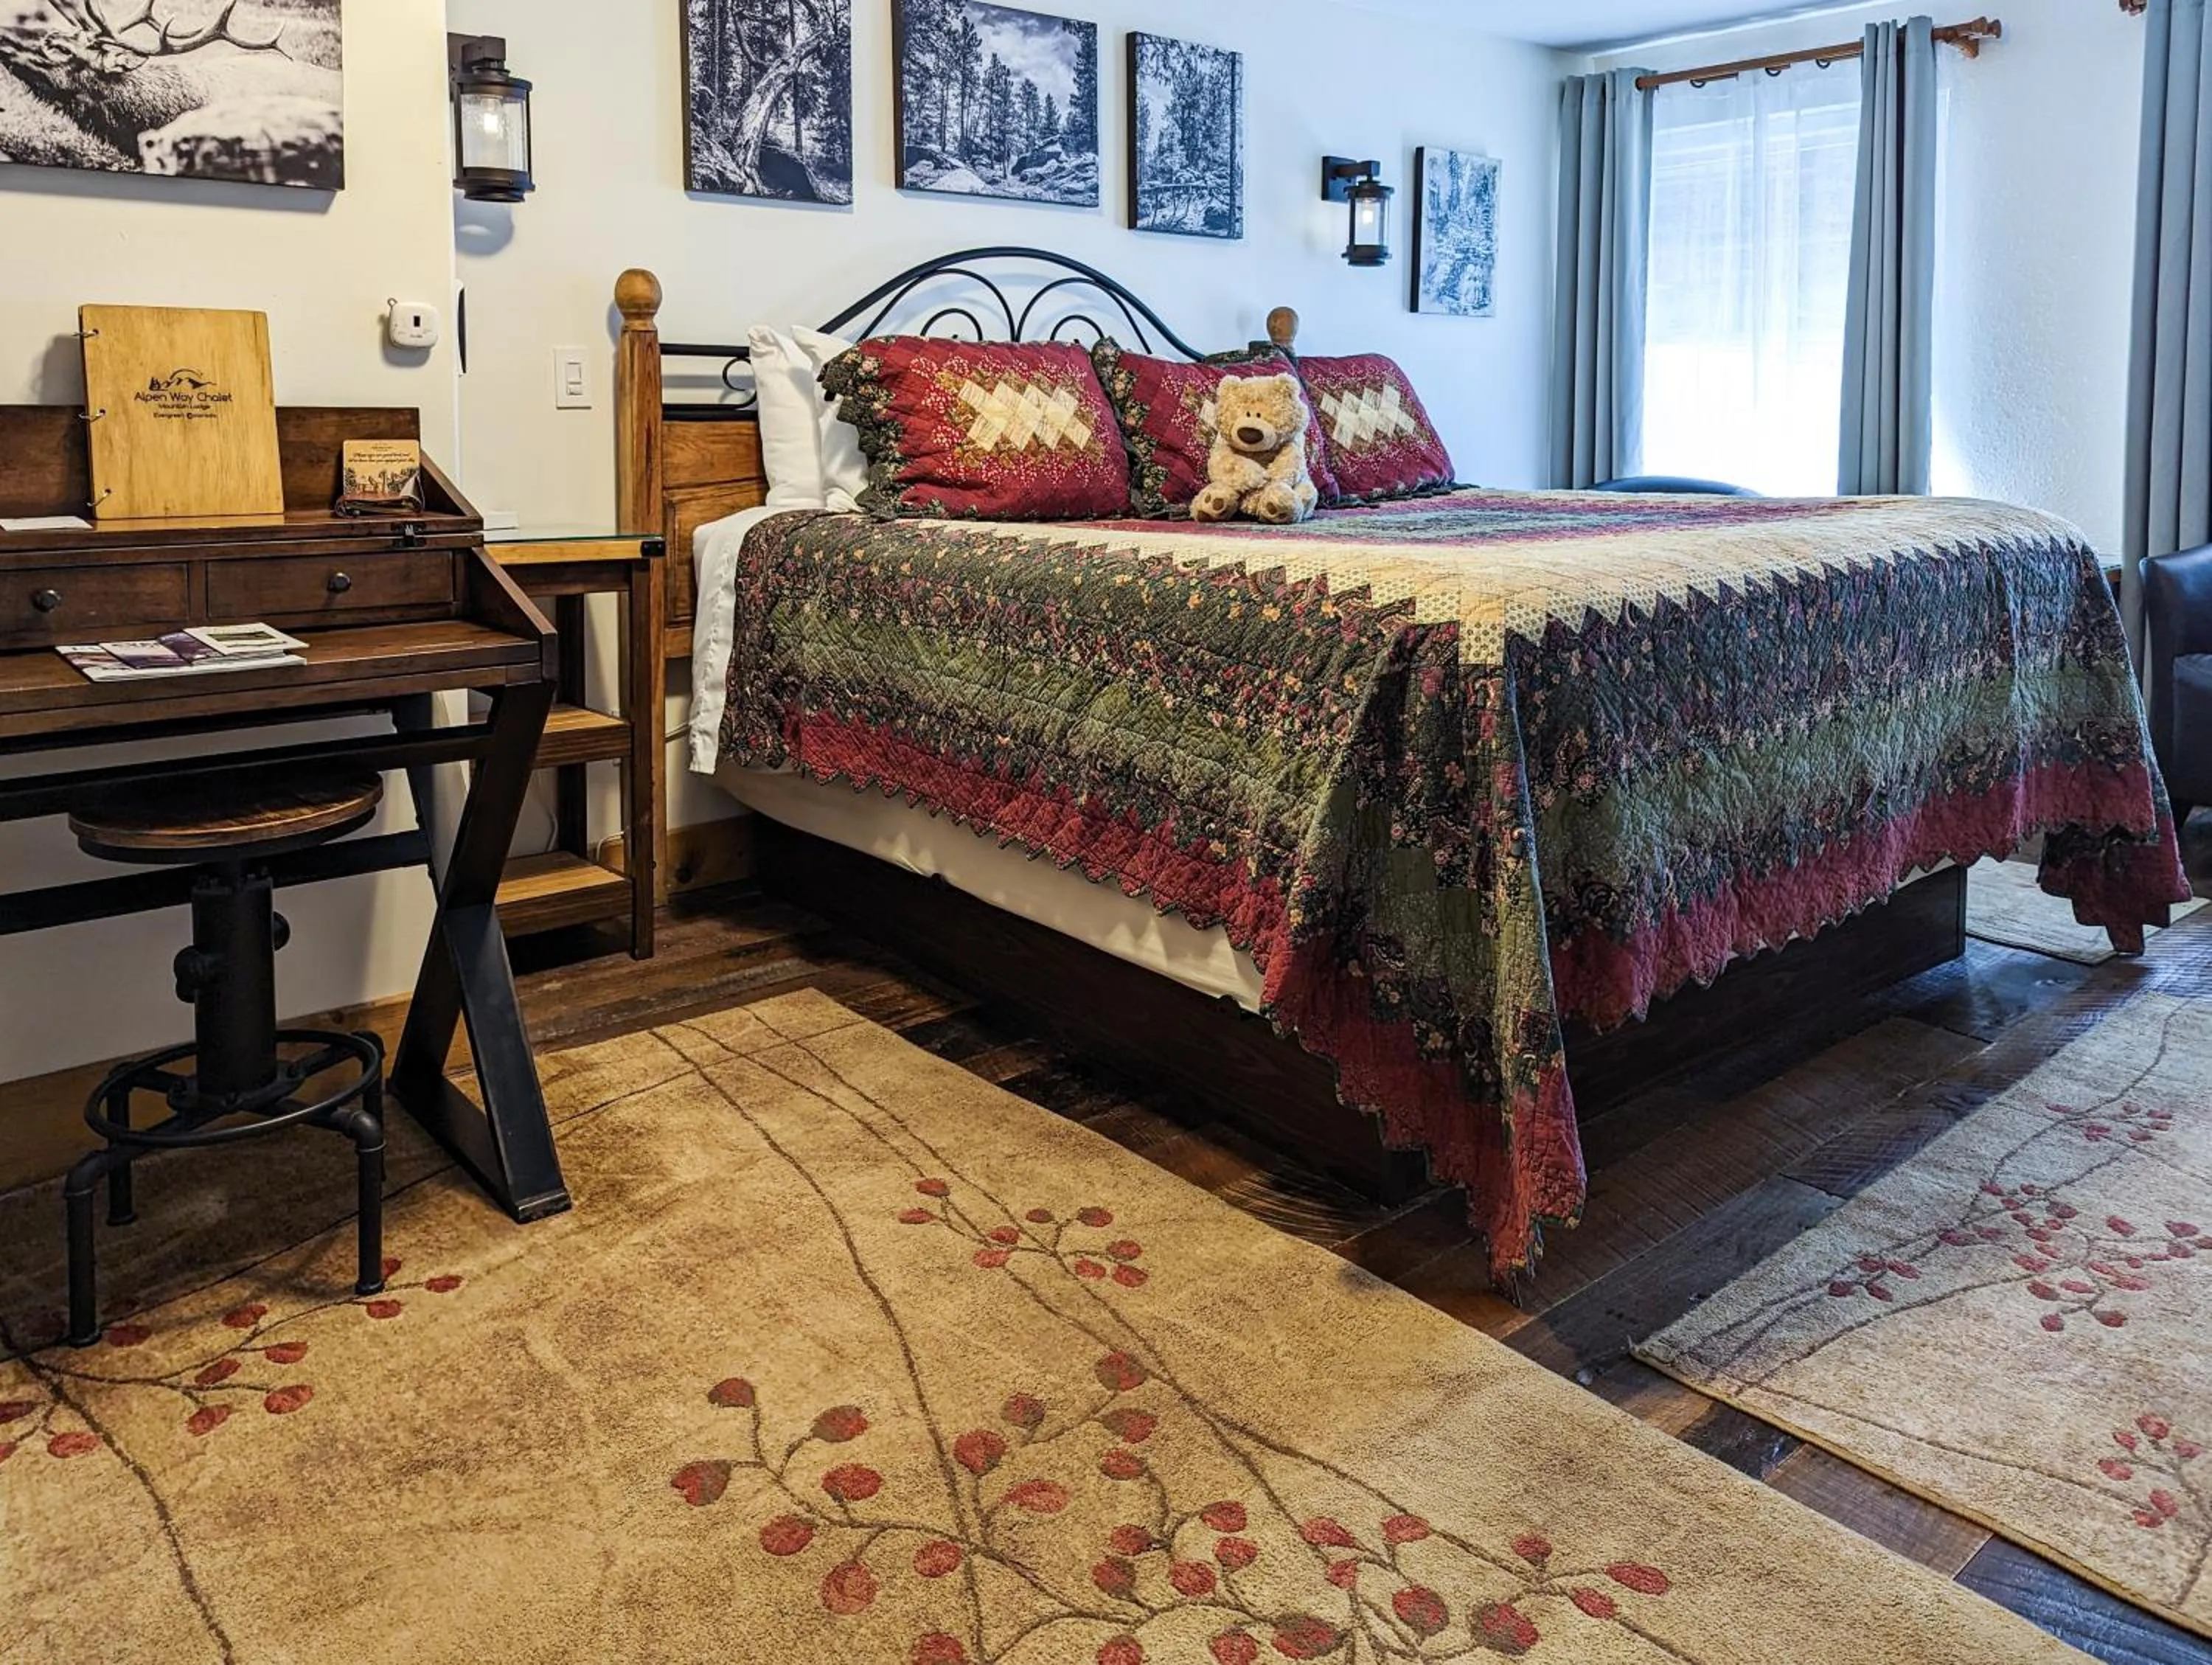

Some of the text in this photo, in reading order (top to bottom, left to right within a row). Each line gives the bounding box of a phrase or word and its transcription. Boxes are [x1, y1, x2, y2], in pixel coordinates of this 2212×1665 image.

[133, 392, 232, 403] Alpen Way Chalet
